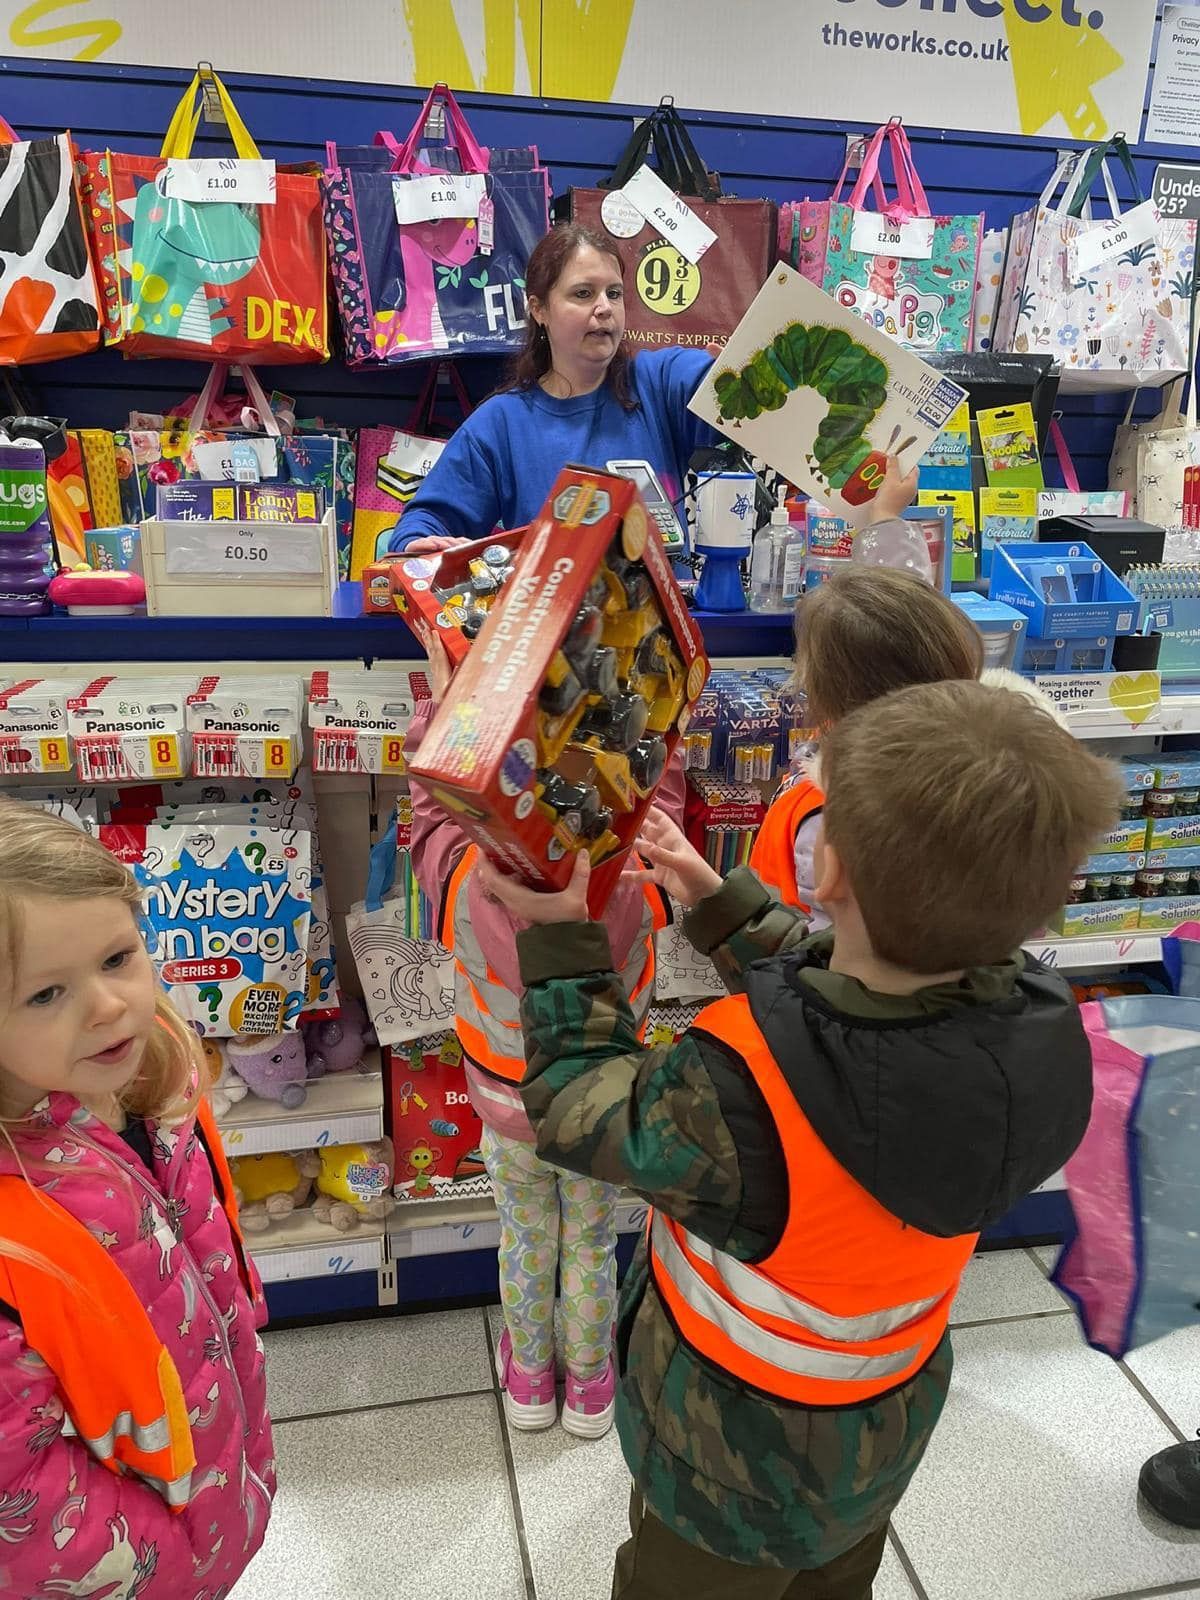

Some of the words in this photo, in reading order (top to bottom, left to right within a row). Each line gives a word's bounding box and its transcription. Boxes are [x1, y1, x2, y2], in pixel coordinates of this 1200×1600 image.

[822, 22, 1009, 62] theworks.co.uk
[1172, 34, 1199, 46] Privacy
[207, 177, 237, 189] £1.00
[431, 190, 457, 203] £1.00
[1157, 197, 1187, 214] 25?
[653, 206, 678, 232] £2.00
[878, 232, 901, 244] £2.00
[1101, 230, 1128, 250] £1.00
[483, 283, 529, 332] FL
[246, 296, 317, 347] DEX
[899, 294, 935, 339] Pig
[677, 333, 731, 348] EXPRES
[919, 371, 938, 390] THE
[933, 388, 957, 408] SAVING
[924, 406, 942, 421] £5.00
[990, 443, 1032, 458] HOORAY!
[235, 458, 256, 468] BAG
[244, 490, 296, 511] Lenny
[246, 505, 297, 523] Henry
[238, 529, 254, 538] Only
[986, 526, 1032, 540] Celebrate!
[225, 545, 268, 561] £0.50
[481, 575, 543, 664] Vehicles
[494, 556, 575, 693] Construction
[1041, 687, 1094, 701] ogether
[50, 708, 62, 719] £1
[130, 705, 141, 715] £1
[233, 708, 244, 718] £1
[359, 710, 369, 718] £1
[0, 721, 59, 732] Panasonic
[86, 717, 166, 733] Panasonic
[204, 718, 280, 732] Panasonic
[325, 715, 397, 730] Panasonic
[729, 719, 779, 730] VARTA
[47, 742, 60, 761] 8
[156, 740, 171, 763] 8
[270, 744, 284, 766] 8
[388, 741, 400, 762] 8
[710, 812, 743, 820] Everyday
[743, 811, 758, 819] Bag
[286, 848, 296, 856] 3+
[267, 858, 284, 871] £5
[1090, 904, 1120, 916] Bubble
[1168, 899, 1197, 911] Bubble
[1083, 912, 1124, 926] Solution
[141, 926, 197, 961] un
[200, 924, 286, 963] bag
[173, 964, 216, 978] SERIES
[220, 963, 229, 976] 3
[248, 989, 280, 1001] EVEN
[243, 1000, 282, 1013] MORE
[244, 1011, 279, 1022] exciting
[239, 1026, 279, 1035] contents
[242, 1020, 277, 1030] mystery
[445, 1090, 472, 1105] Bo
